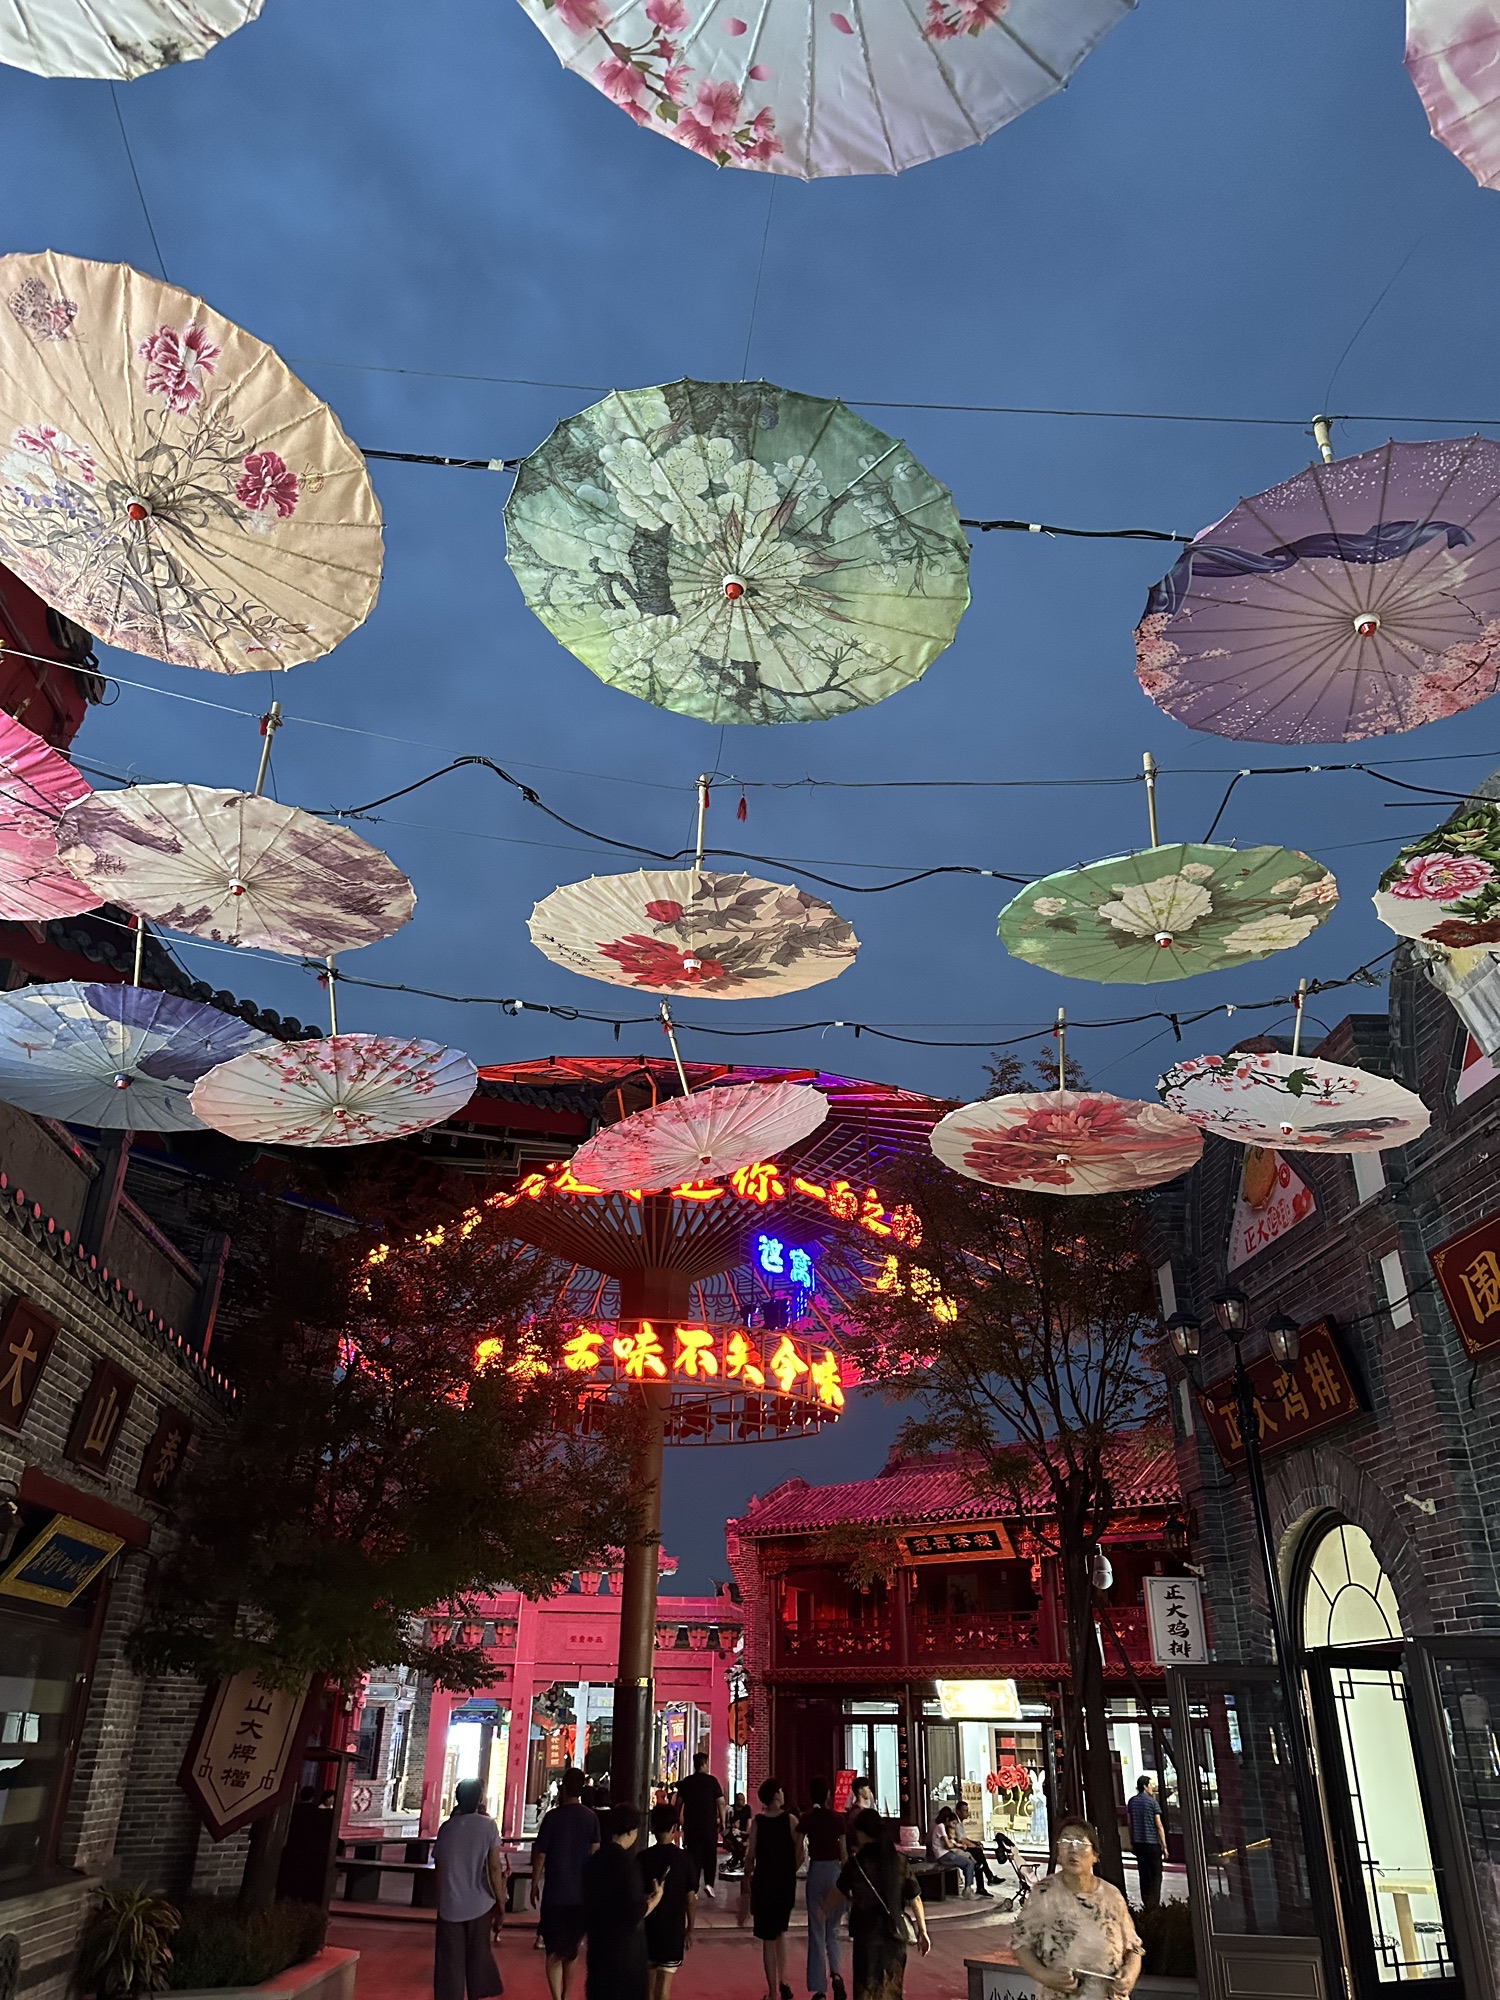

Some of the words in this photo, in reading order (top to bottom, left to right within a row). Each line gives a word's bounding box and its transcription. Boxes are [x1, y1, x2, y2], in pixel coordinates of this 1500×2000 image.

[83, 1386, 119, 1457] 山
[1164, 1584, 1192, 1658] 正大鸡排
